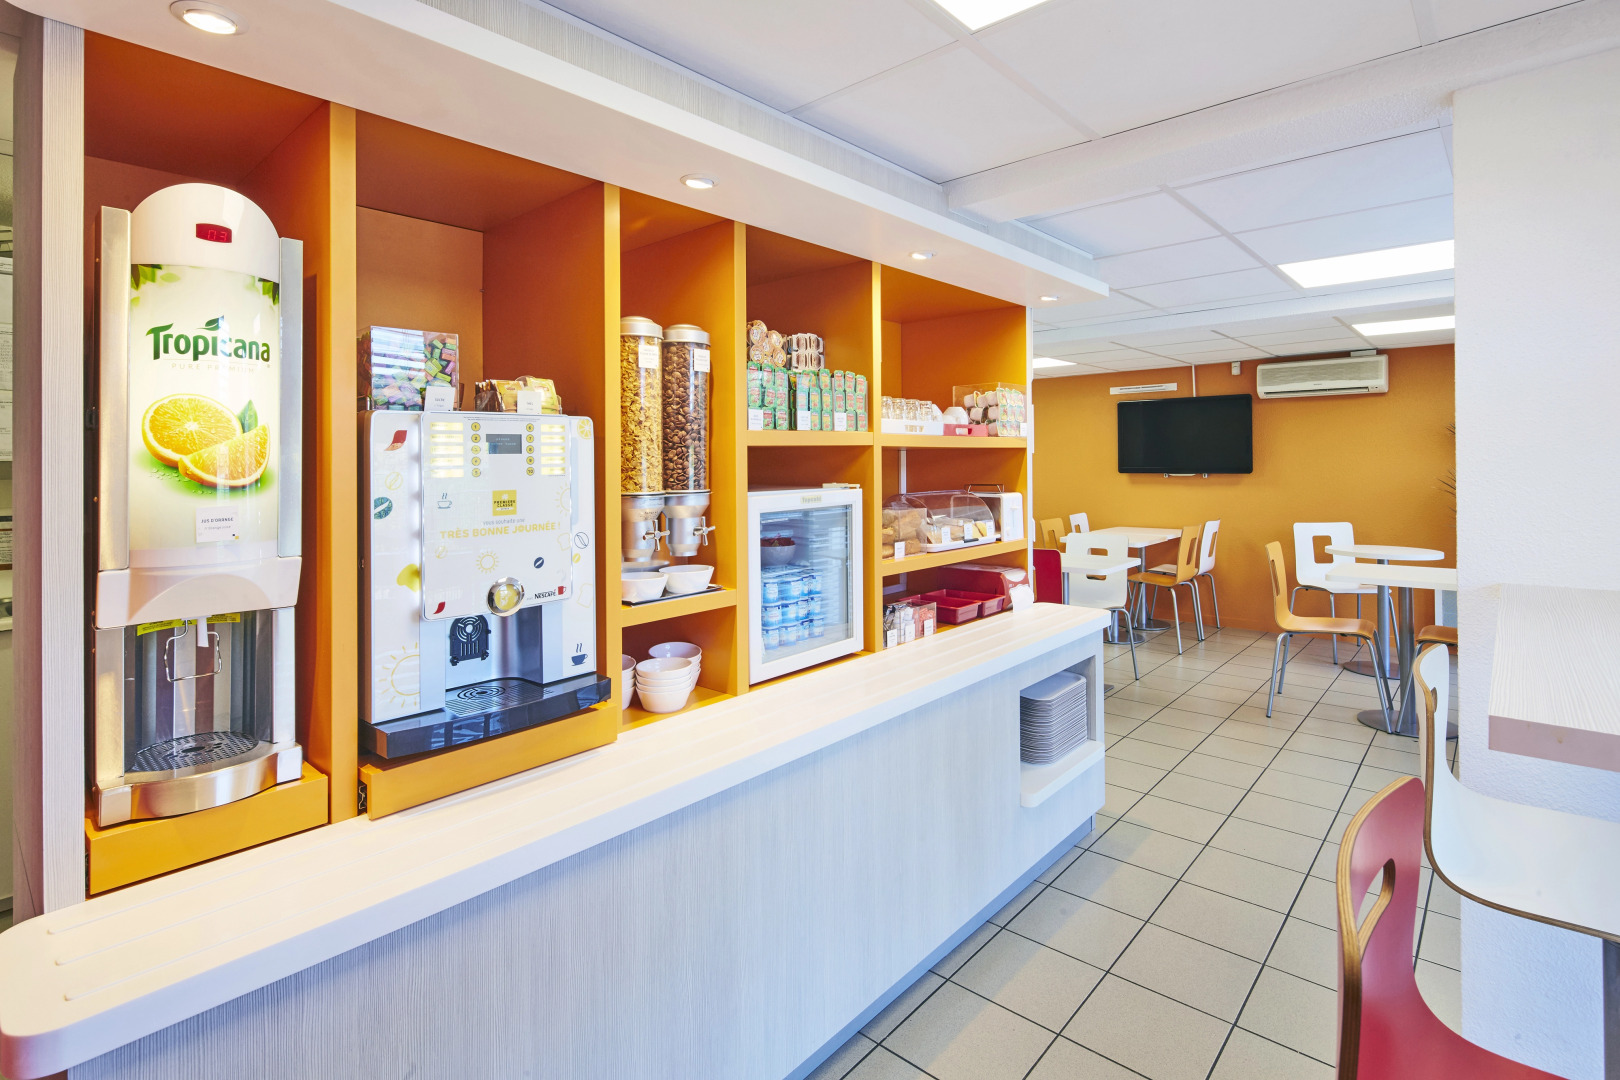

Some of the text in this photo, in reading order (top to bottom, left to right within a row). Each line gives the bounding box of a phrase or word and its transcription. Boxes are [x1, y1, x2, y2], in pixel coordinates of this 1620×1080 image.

[146, 323, 271, 362] Tropicana
[207, 364, 254, 373] PRMIUM
[440, 528, 470, 539] TRÈS
[472, 526, 510, 537] BONNE
[512, 521, 556, 534] JOURNÉE
